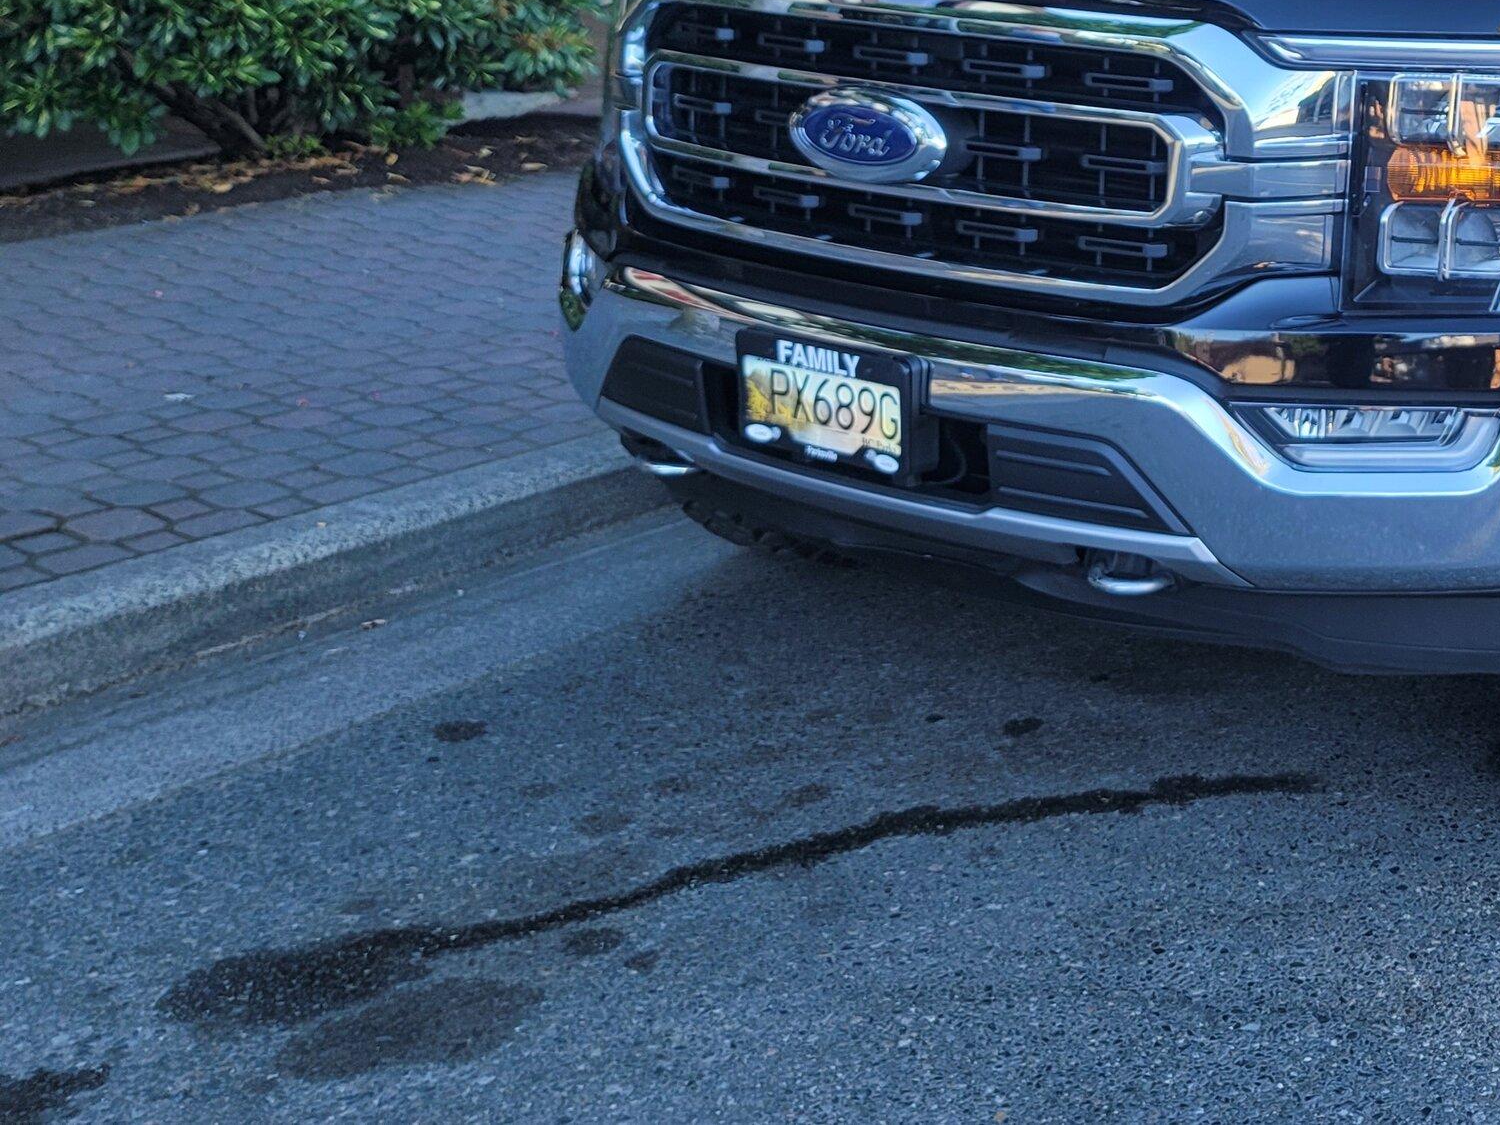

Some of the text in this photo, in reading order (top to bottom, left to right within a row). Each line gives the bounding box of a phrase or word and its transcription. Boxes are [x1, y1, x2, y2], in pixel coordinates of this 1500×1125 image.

[818, 111, 890, 157] Ford
[775, 338, 860, 378] FAMILY
[769, 367, 900, 440] PX689G
